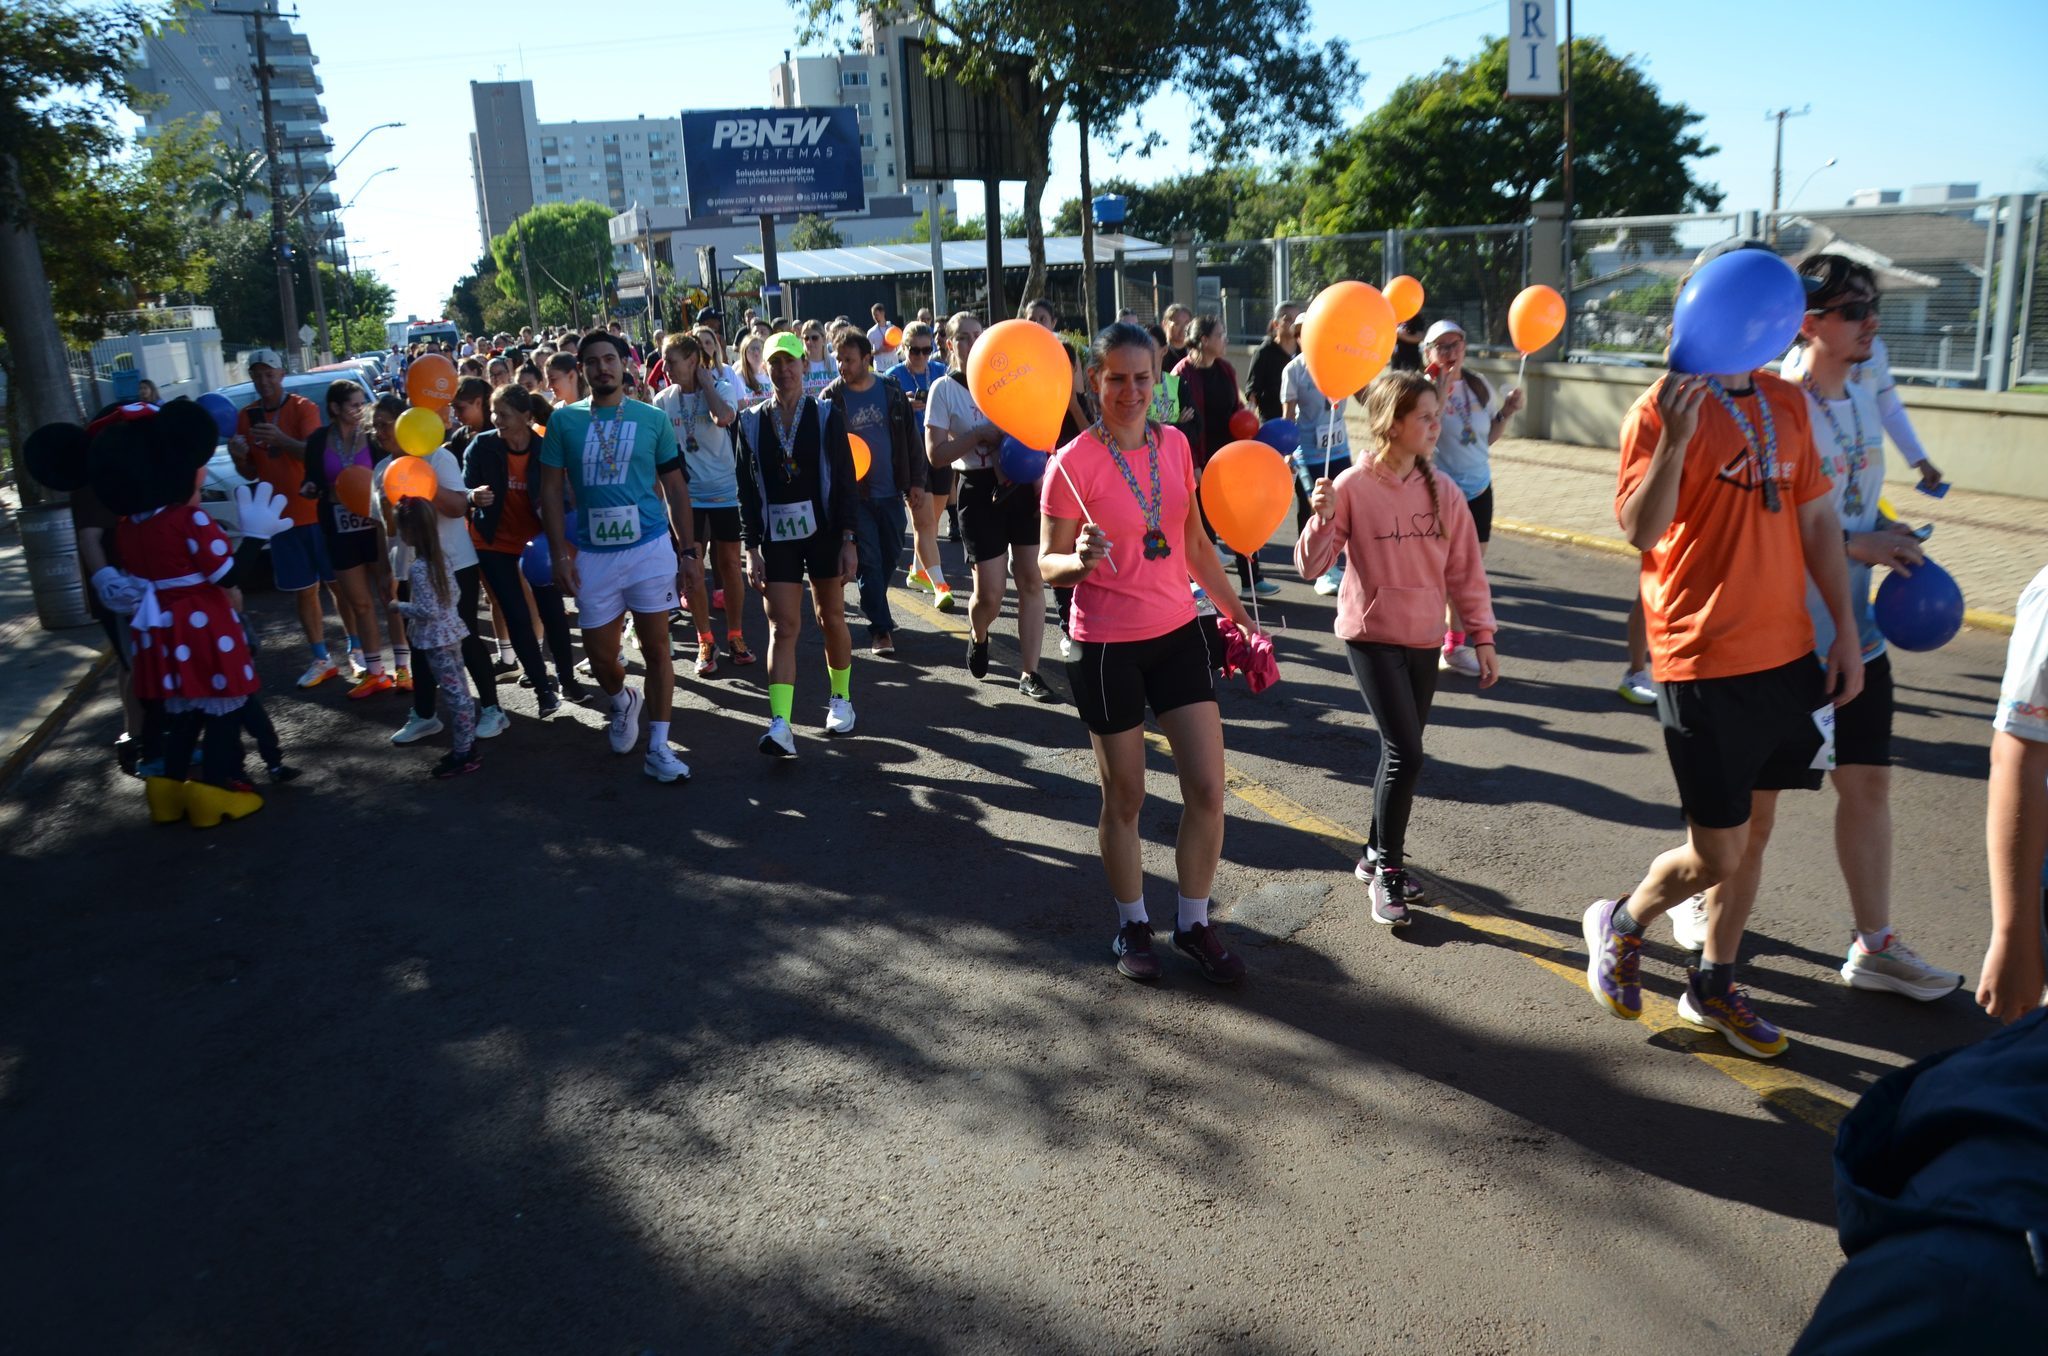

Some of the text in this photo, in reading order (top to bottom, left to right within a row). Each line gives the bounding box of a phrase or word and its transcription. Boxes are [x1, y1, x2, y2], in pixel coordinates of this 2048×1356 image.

[712, 116, 831, 149] PBNEW
[742, 146, 833, 161] SISTEMAS
[735, 166, 815, 178] Soluções tecnológicas
[736, 177, 747, 185] em
[748, 176, 780, 186] produtos
[714, 196, 756, 206] pbnew.com.br
[987, 363, 1036, 396] CRESOL
[596, 520, 634, 541] 444
[776, 515, 808, 537] 411
